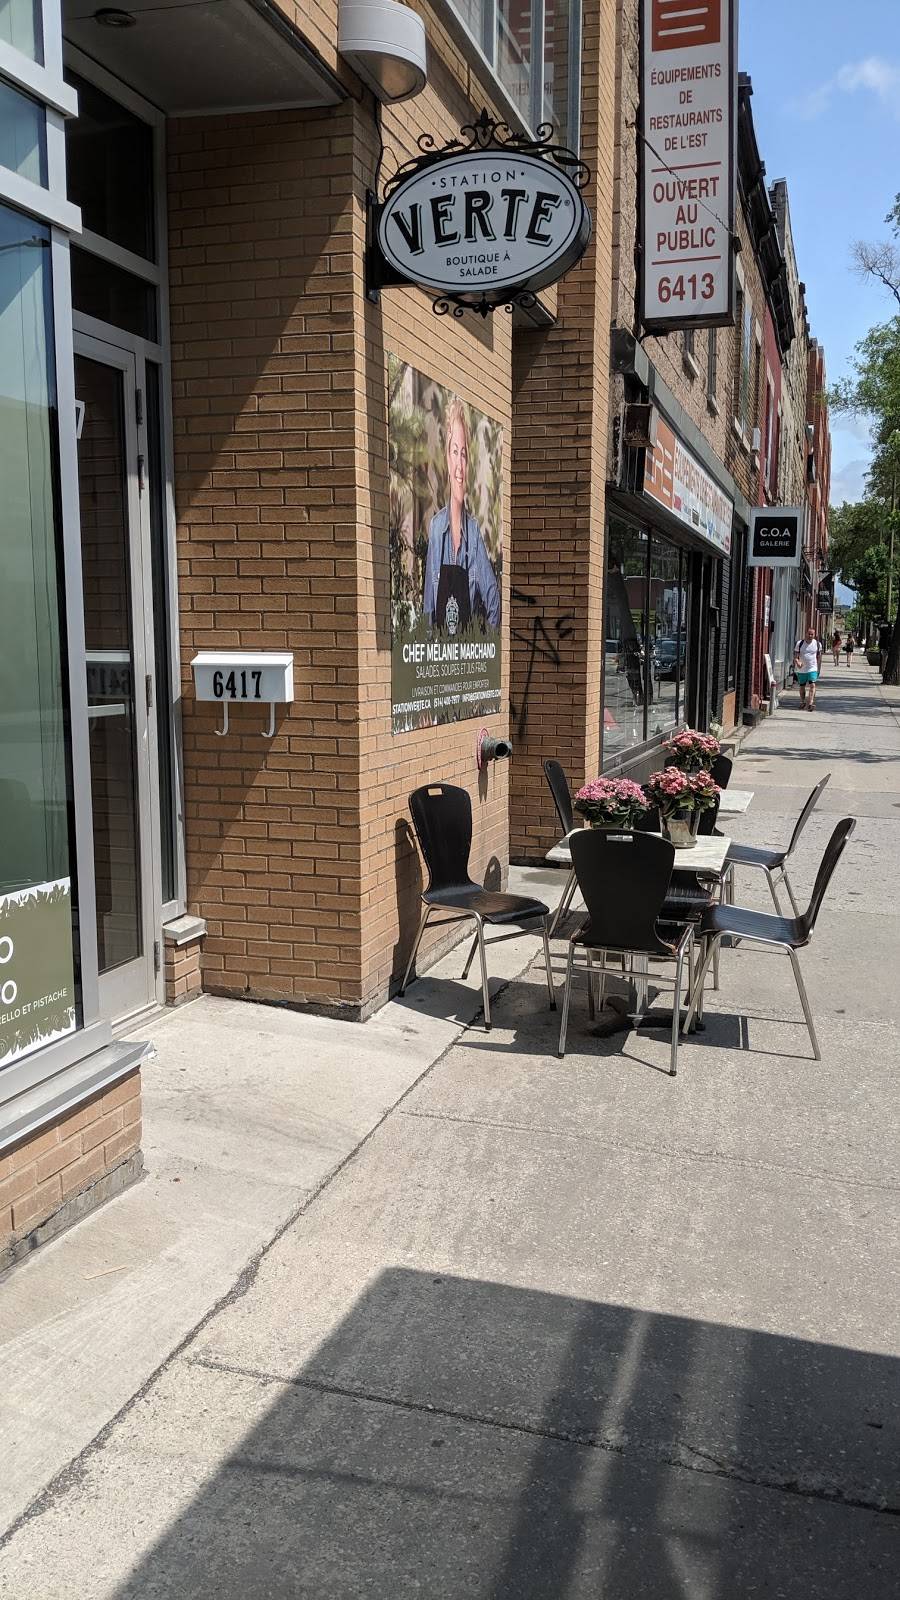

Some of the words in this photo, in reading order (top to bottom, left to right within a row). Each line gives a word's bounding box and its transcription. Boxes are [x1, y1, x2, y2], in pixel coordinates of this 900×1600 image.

[650, 62, 721, 86] ÉQUIPEMENTS
[679, 90, 693, 104] DE
[650, 108, 723, 130] RESTAURANTS
[664, 136, 678, 151] DE
[681, 133, 708, 149] L'EST
[440, 170, 516, 188] STATION
[653, 176, 720, 203] OUVERT
[676, 204, 698, 225] AU
[657, 226, 716, 252] PUBLIC
[446, 253, 500, 267] BOUTIQUE
[503, 250, 510, 261] À
[460, 266, 498, 277] SALADE
[658, 273, 714, 303] 6413
[760, 528, 790, 537] C.O.A
[402, 643, 426, 662] CHEF
[427, 638, 458, 662] MÉLANIE
[460, 642, 496, 660] MARCHAND
[441, 663, 460, 676] SOUPES
[460, 663, 466, 674] ET
[475, 661, 487, 673] FRAIS
[213, 670, 262, 698] 6417
[434, 684, 439, 695] ET
[0, 1008, 20, 1024] ELLO
[22, 1002, 31, 1015] ET
[33, 988, 68, 1010] PISTACHE
